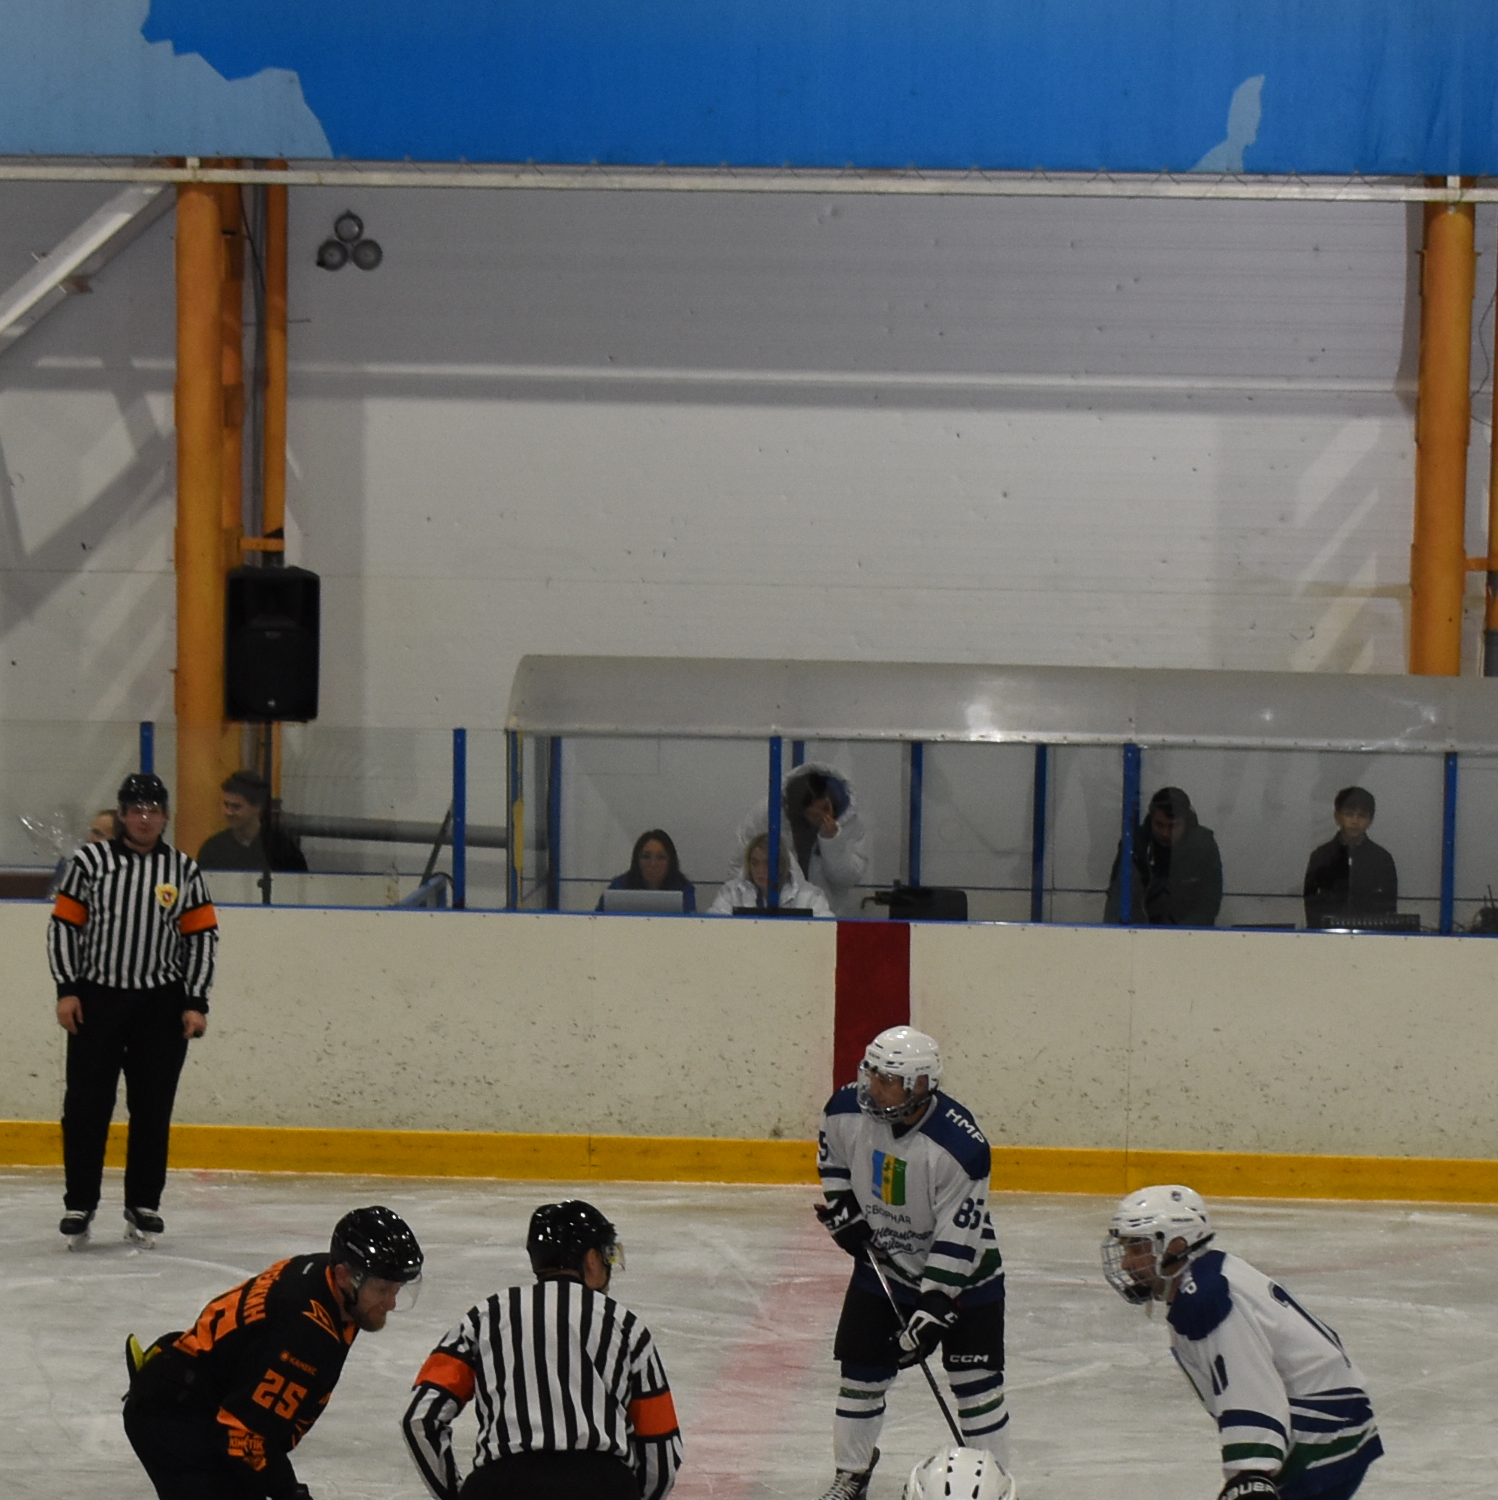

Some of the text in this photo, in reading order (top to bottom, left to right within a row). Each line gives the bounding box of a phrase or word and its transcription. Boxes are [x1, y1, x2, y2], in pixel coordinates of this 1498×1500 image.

[945, 1108, 985, 1144] НМР
[818, 1131, 829, 1162] 5
[949, 1354, 990, 1363] CCM
[252, 1368, 309, 1421] 25
